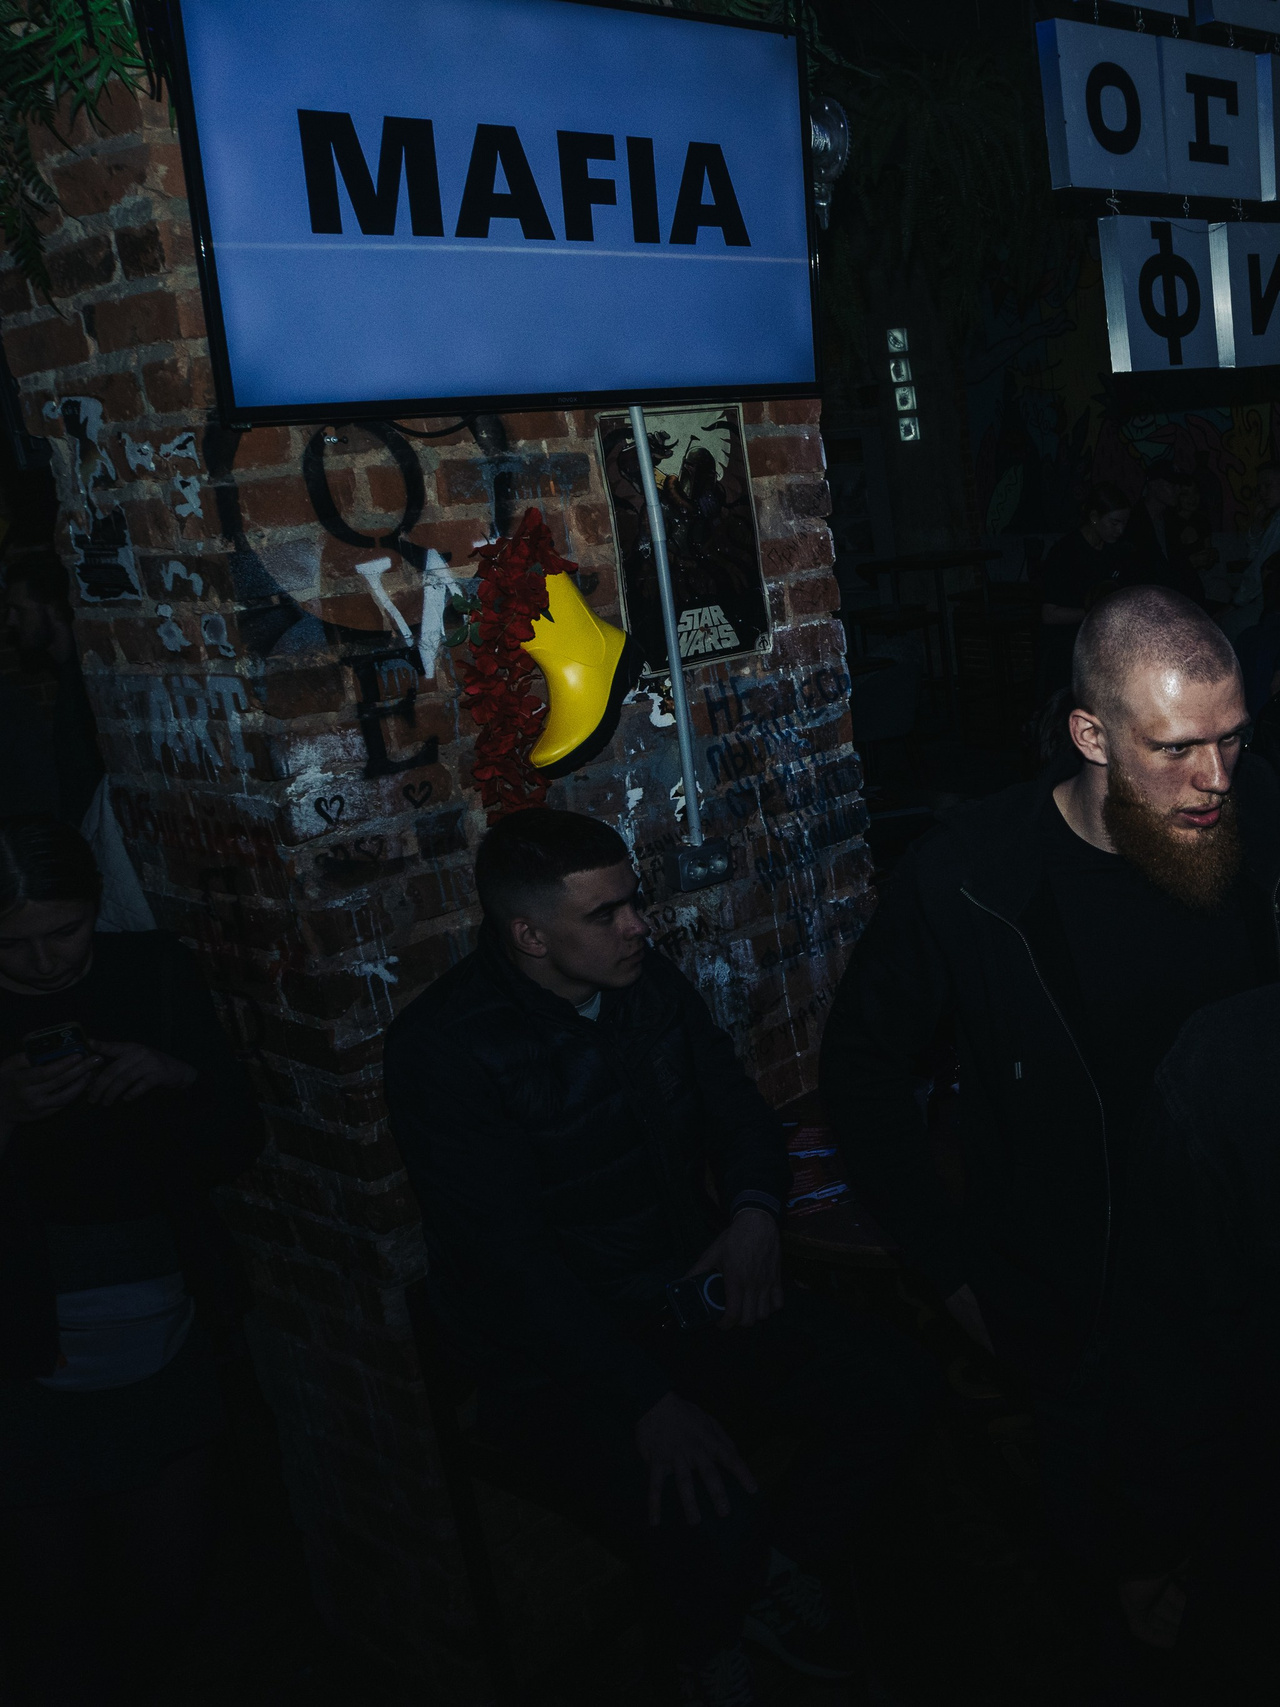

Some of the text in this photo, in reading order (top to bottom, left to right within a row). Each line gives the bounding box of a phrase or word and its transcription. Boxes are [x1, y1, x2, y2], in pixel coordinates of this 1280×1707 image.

[297, 108, 752, 248] MAFIA
[677, 604, 730, 633] STAR
[665, 623, 741, 662] WARS
